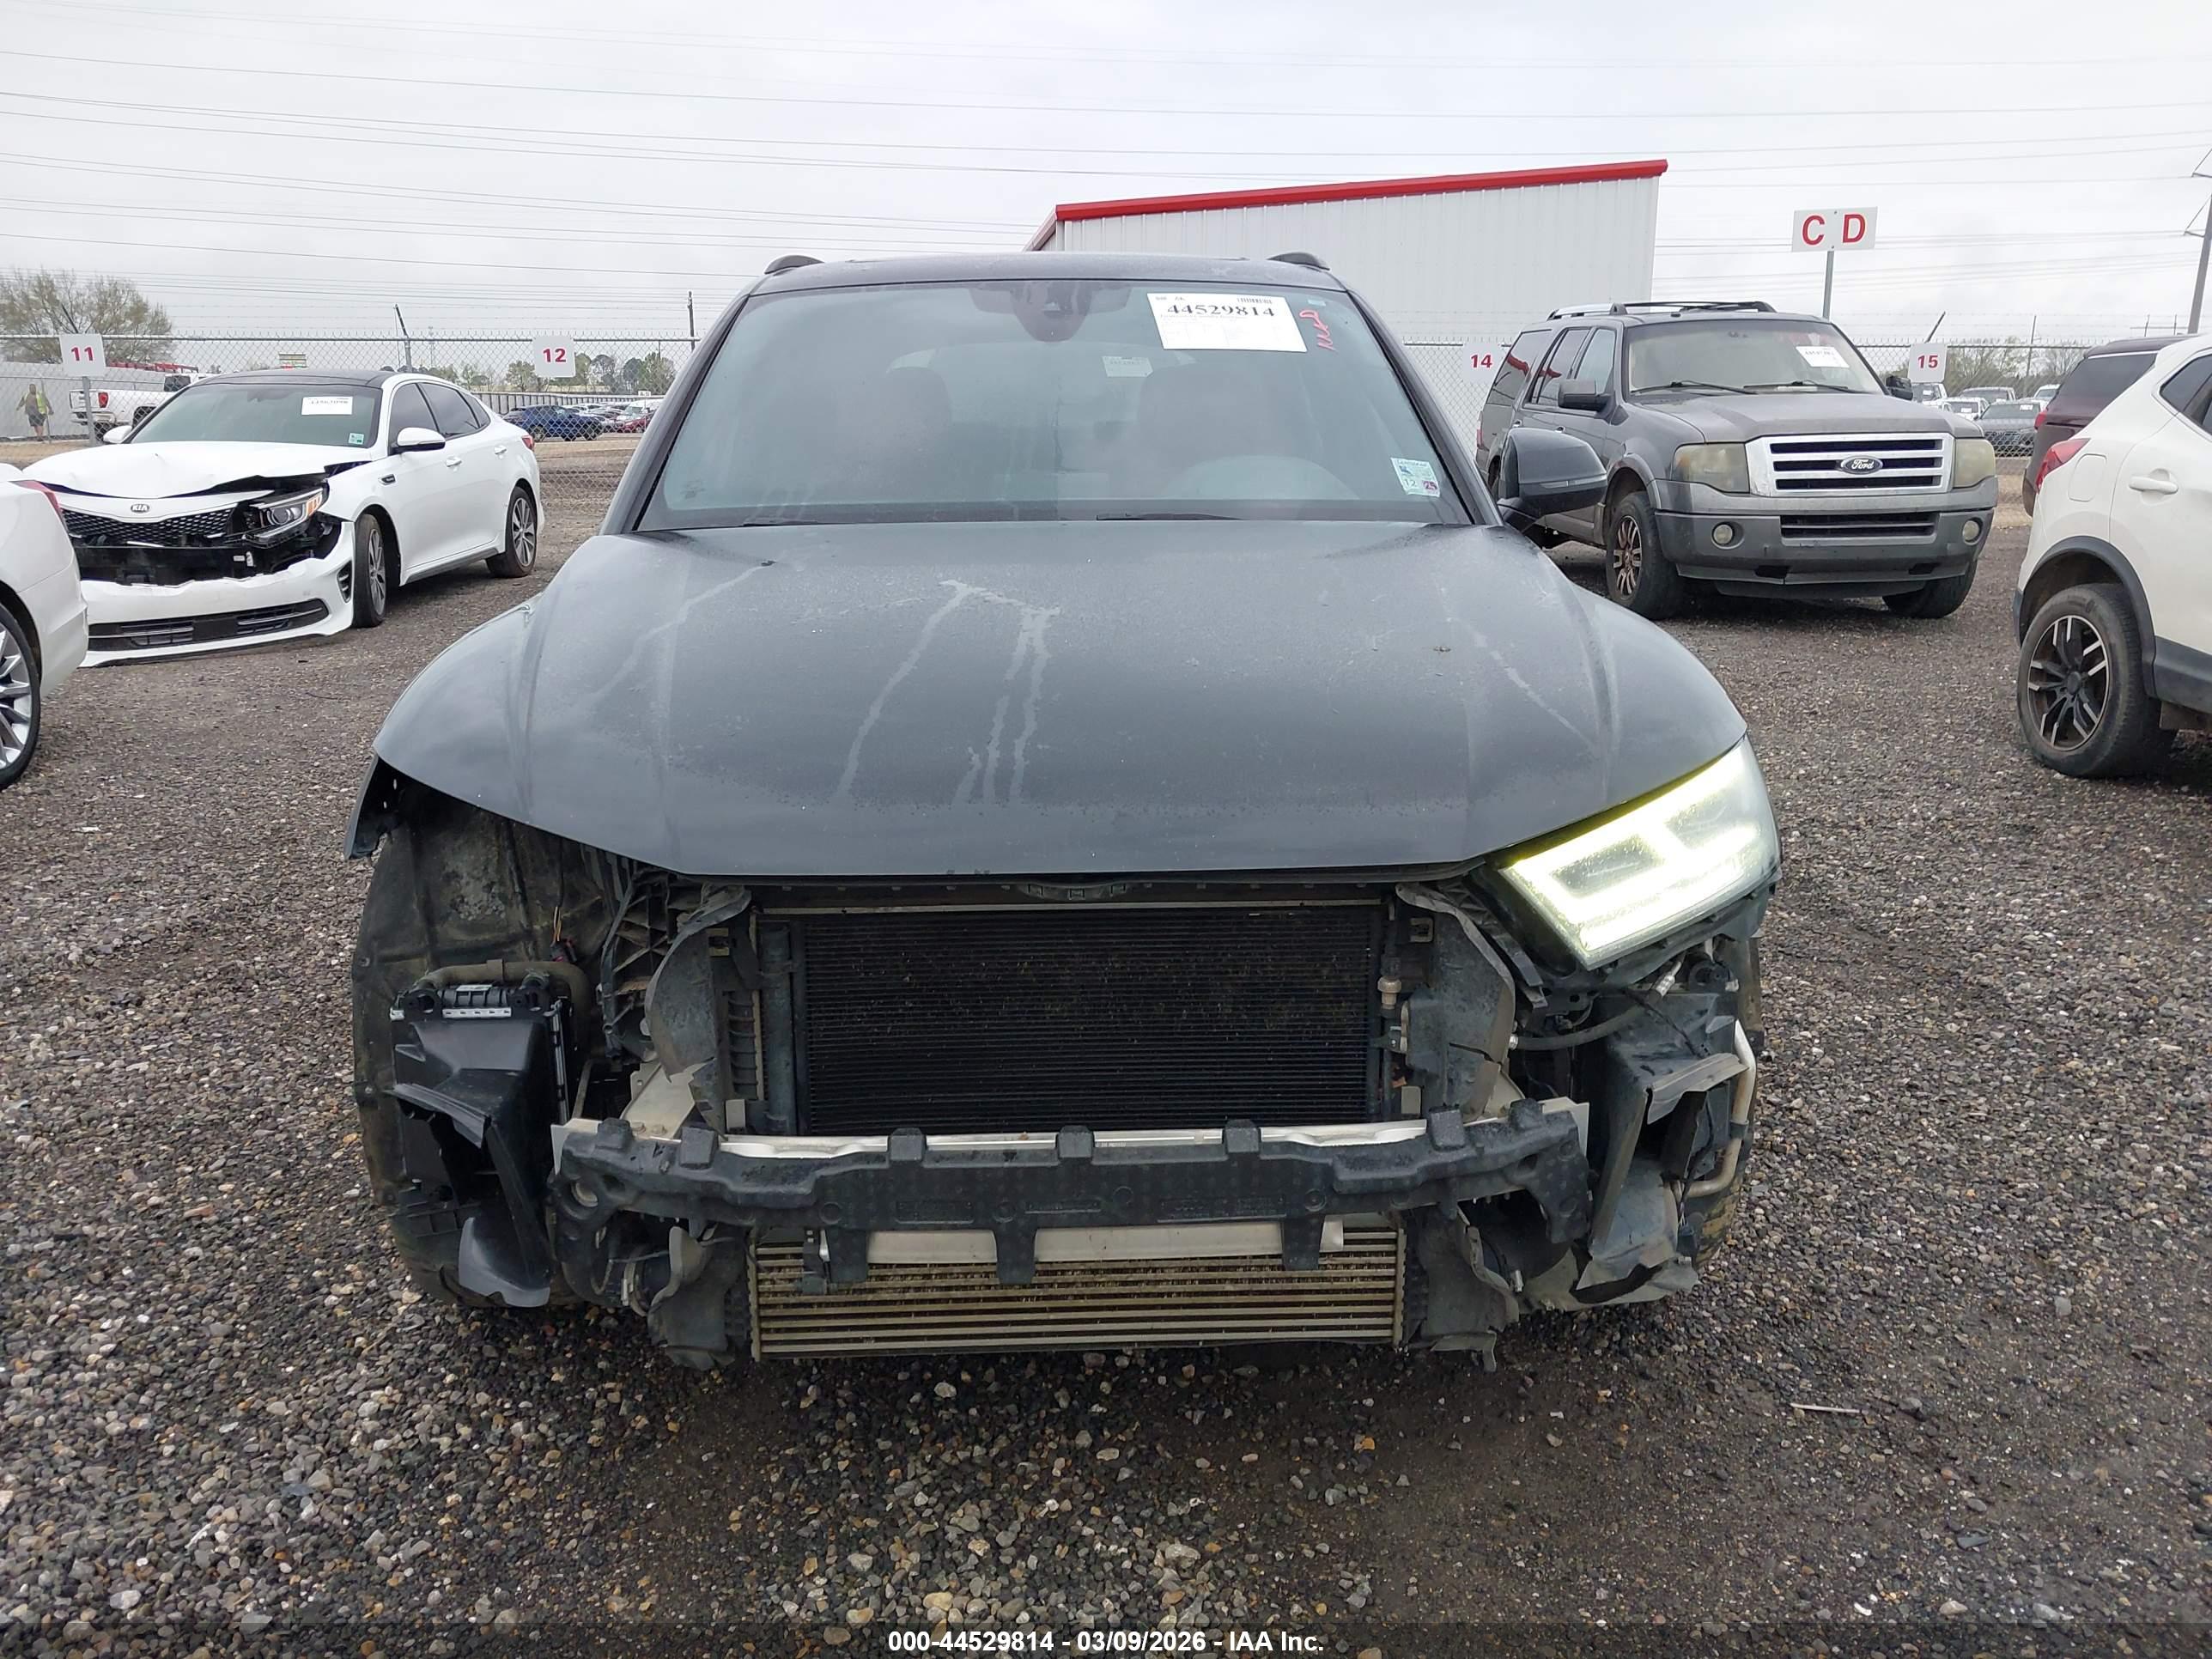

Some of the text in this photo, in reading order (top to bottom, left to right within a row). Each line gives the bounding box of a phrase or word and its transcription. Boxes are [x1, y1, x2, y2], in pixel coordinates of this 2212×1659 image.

[1802, 214, 1866, 245] C D
[1167, 304, 1275, 317] 44529814
[71, 347, 94, 362] 11
[544, 348, 567, 362] 12
[1471, 355, 1492, 368] 14
[1917, 355, 1939, 368] 15
[1850, 459, 1875, 470] Ford
